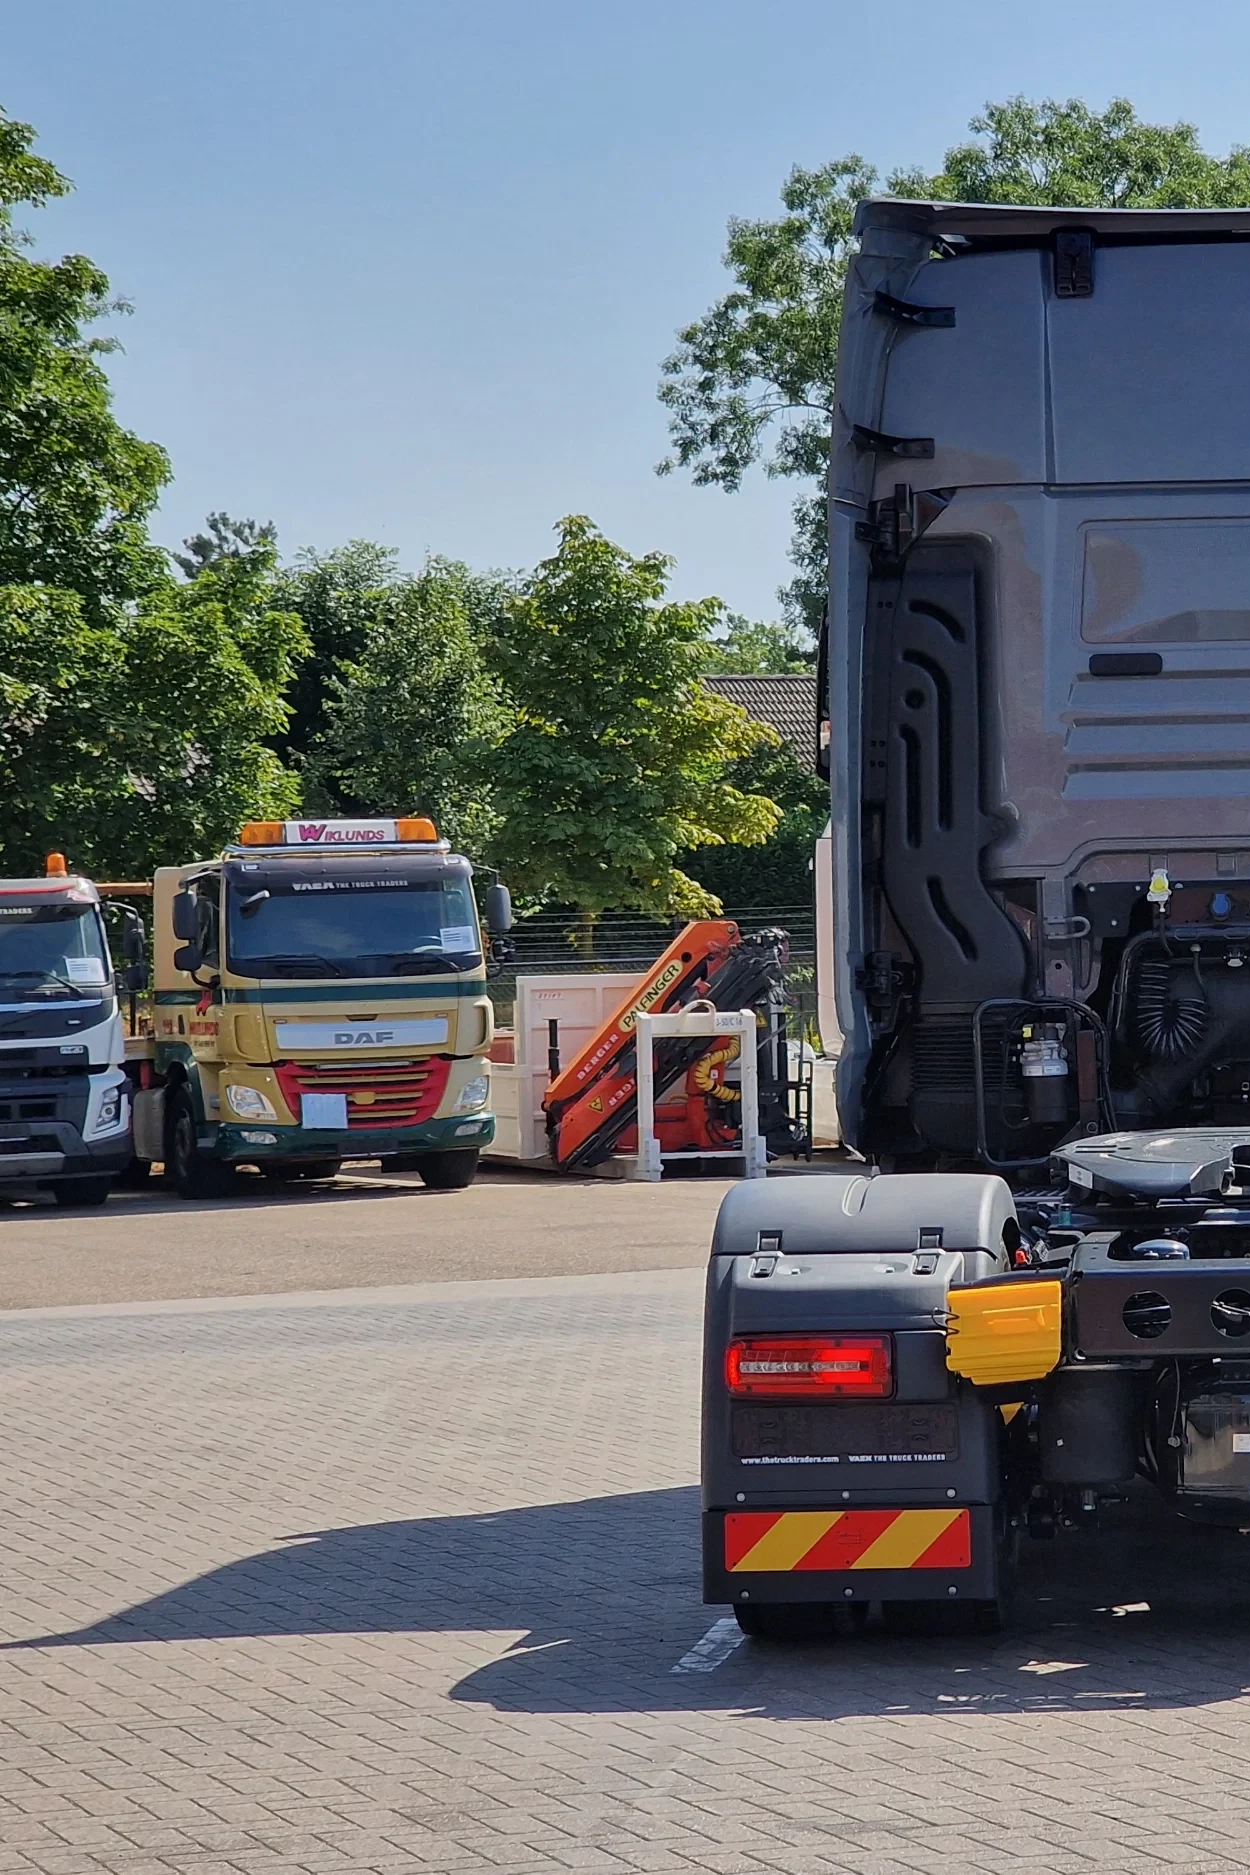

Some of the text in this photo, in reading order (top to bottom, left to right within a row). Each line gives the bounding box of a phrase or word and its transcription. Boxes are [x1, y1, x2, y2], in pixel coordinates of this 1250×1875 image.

[298, 823, 385, 842] WIKLUNDS
[377, 880, 408, 888] TRADERS
[622, 964, 680, 1028] PALFINGER
[334, 1031, 394, 1045] DAF
[741, 1455, 840, 1465] www.thetrucktraders.com
[889, 1454, 912, 1462] TRUCK
[913, 1453, 946, 1461] TRADERS
